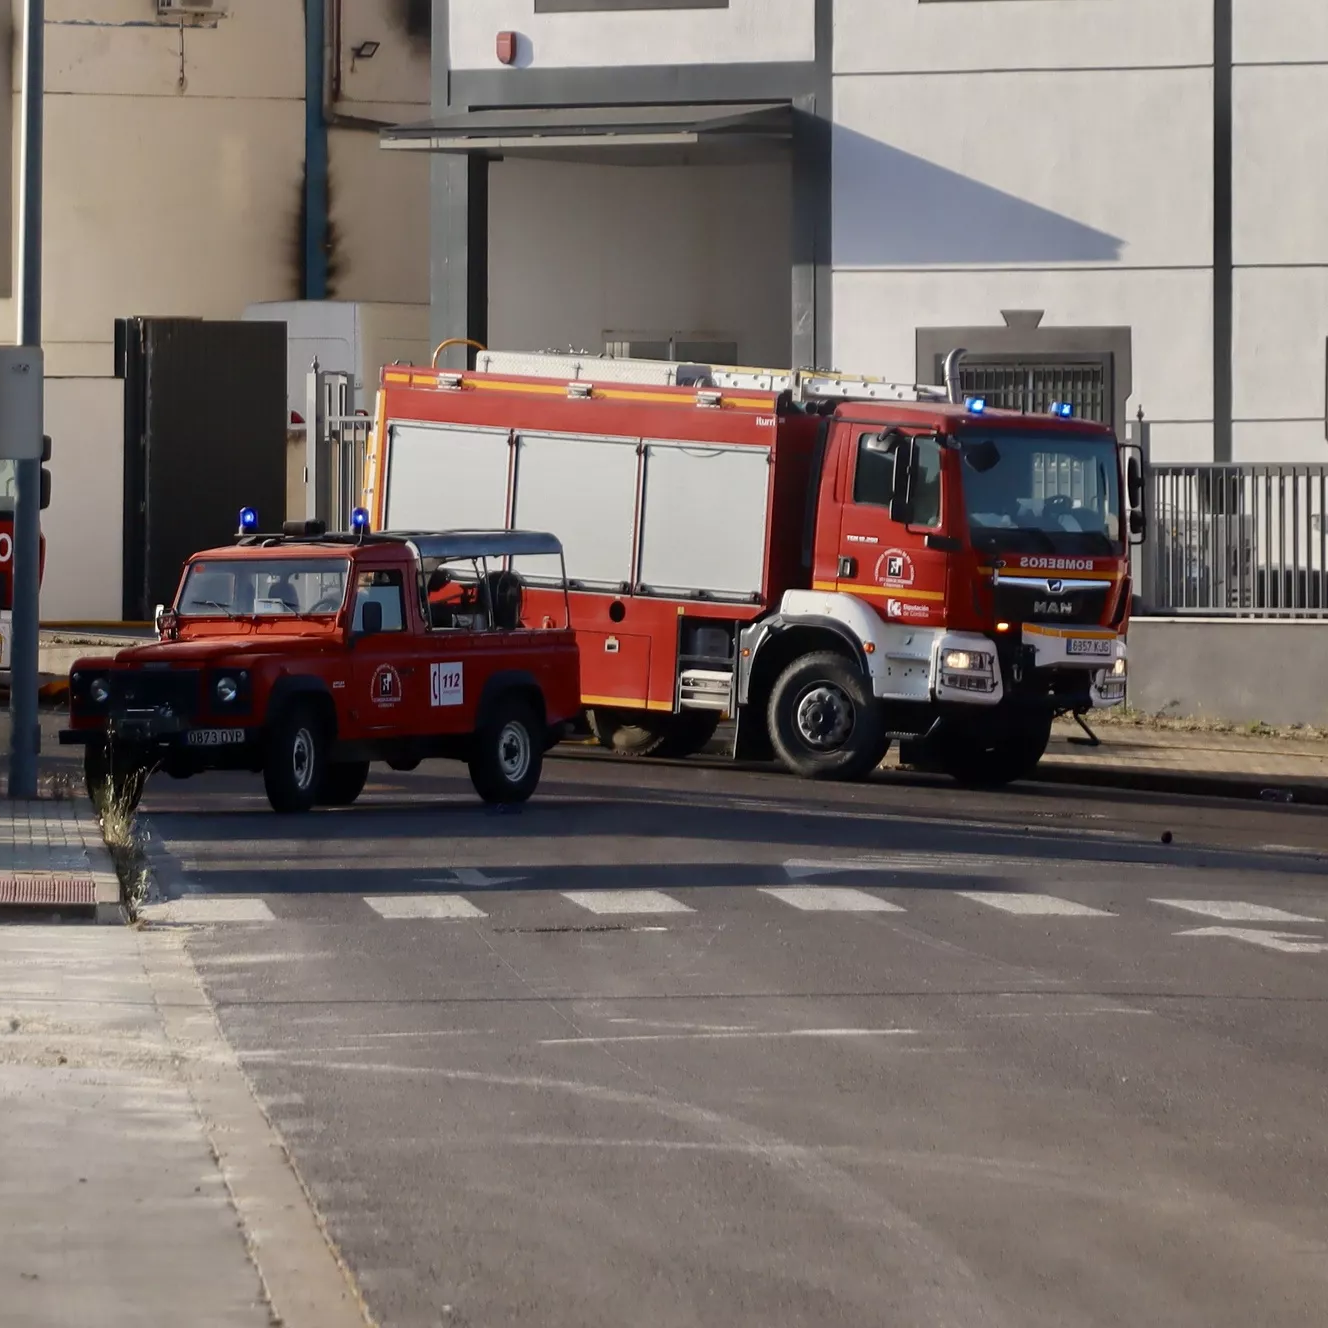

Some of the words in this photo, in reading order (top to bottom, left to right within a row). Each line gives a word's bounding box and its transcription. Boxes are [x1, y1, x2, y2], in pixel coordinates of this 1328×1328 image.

[1033, 601, 1073, 613] MAN
[442, 672, 461, 688] 112
[188, 731, 218, 744] 0873
